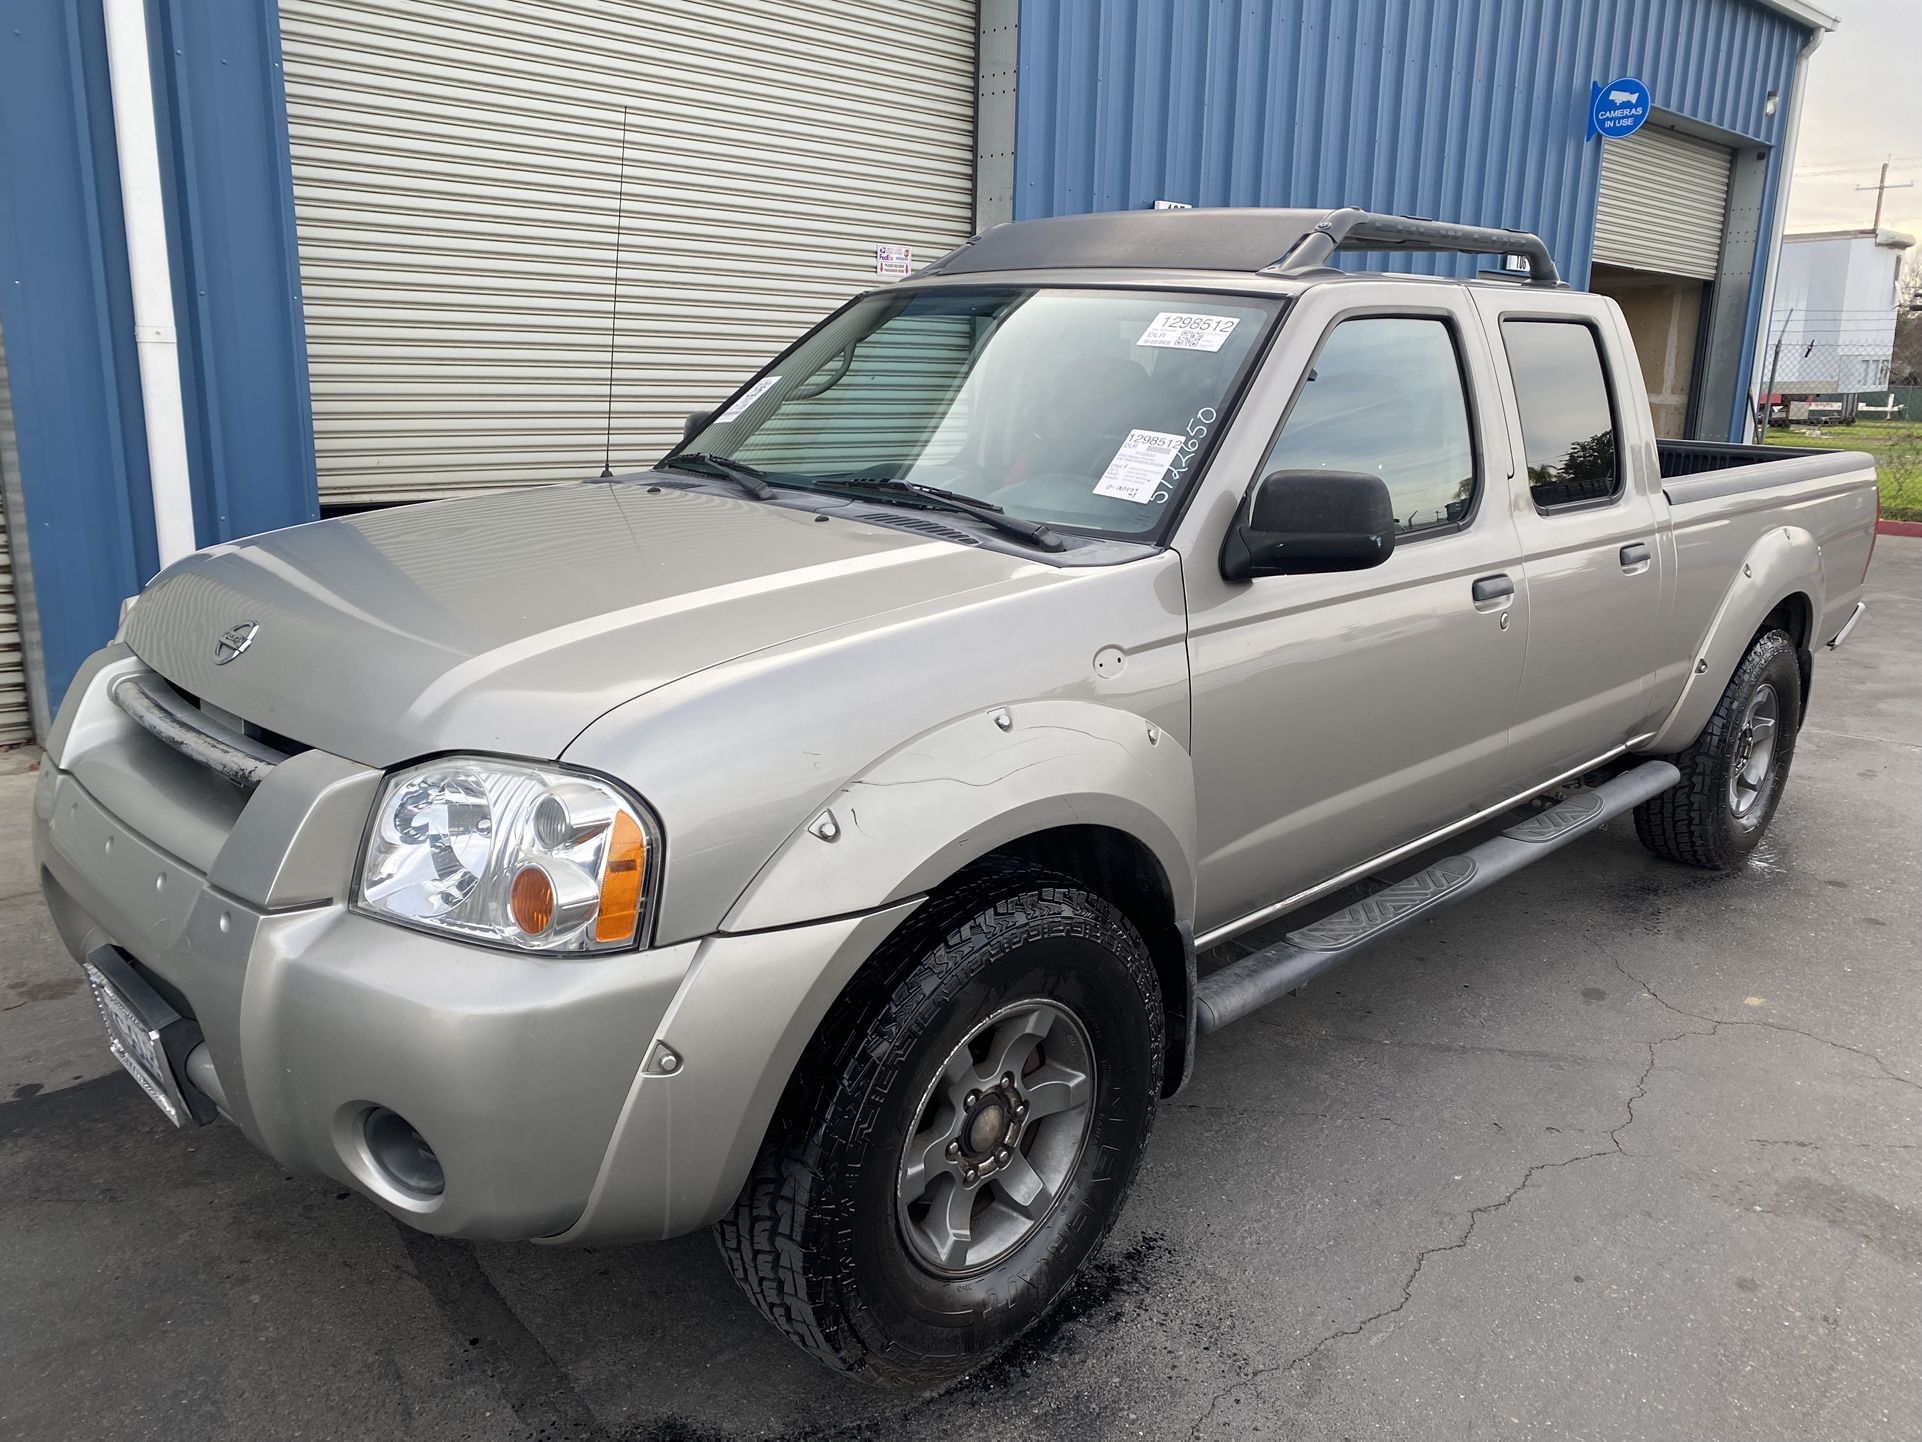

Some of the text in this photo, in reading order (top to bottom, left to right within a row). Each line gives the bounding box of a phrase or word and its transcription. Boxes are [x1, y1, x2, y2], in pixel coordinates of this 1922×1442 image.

[1598, 107, 1643, 119] CAMERAS
[1604, 118, 1635, 128] IN USE
[1161, 315, 1235, 333] 1298512
[1147, 331, 1167, 339] DLR
[1127, 432, 1183, 450] 1298512
